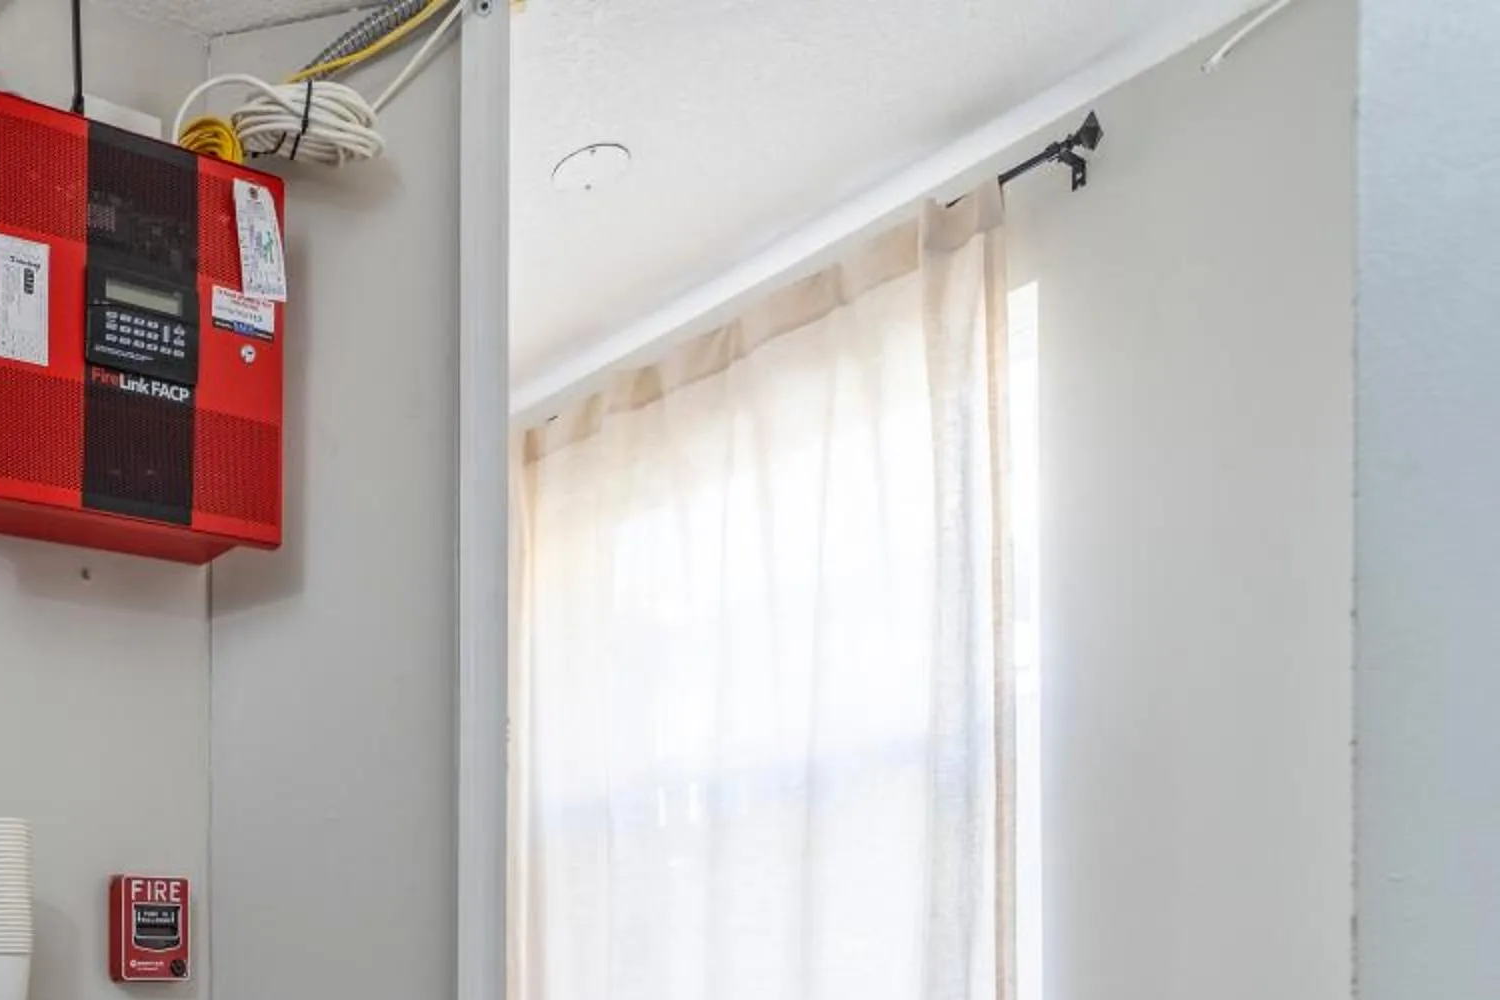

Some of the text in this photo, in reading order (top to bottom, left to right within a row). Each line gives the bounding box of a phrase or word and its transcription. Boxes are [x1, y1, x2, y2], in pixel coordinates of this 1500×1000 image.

[91, 367, 190, 403] FireLink FACP
[131, 879, 182, 902] FIRE
